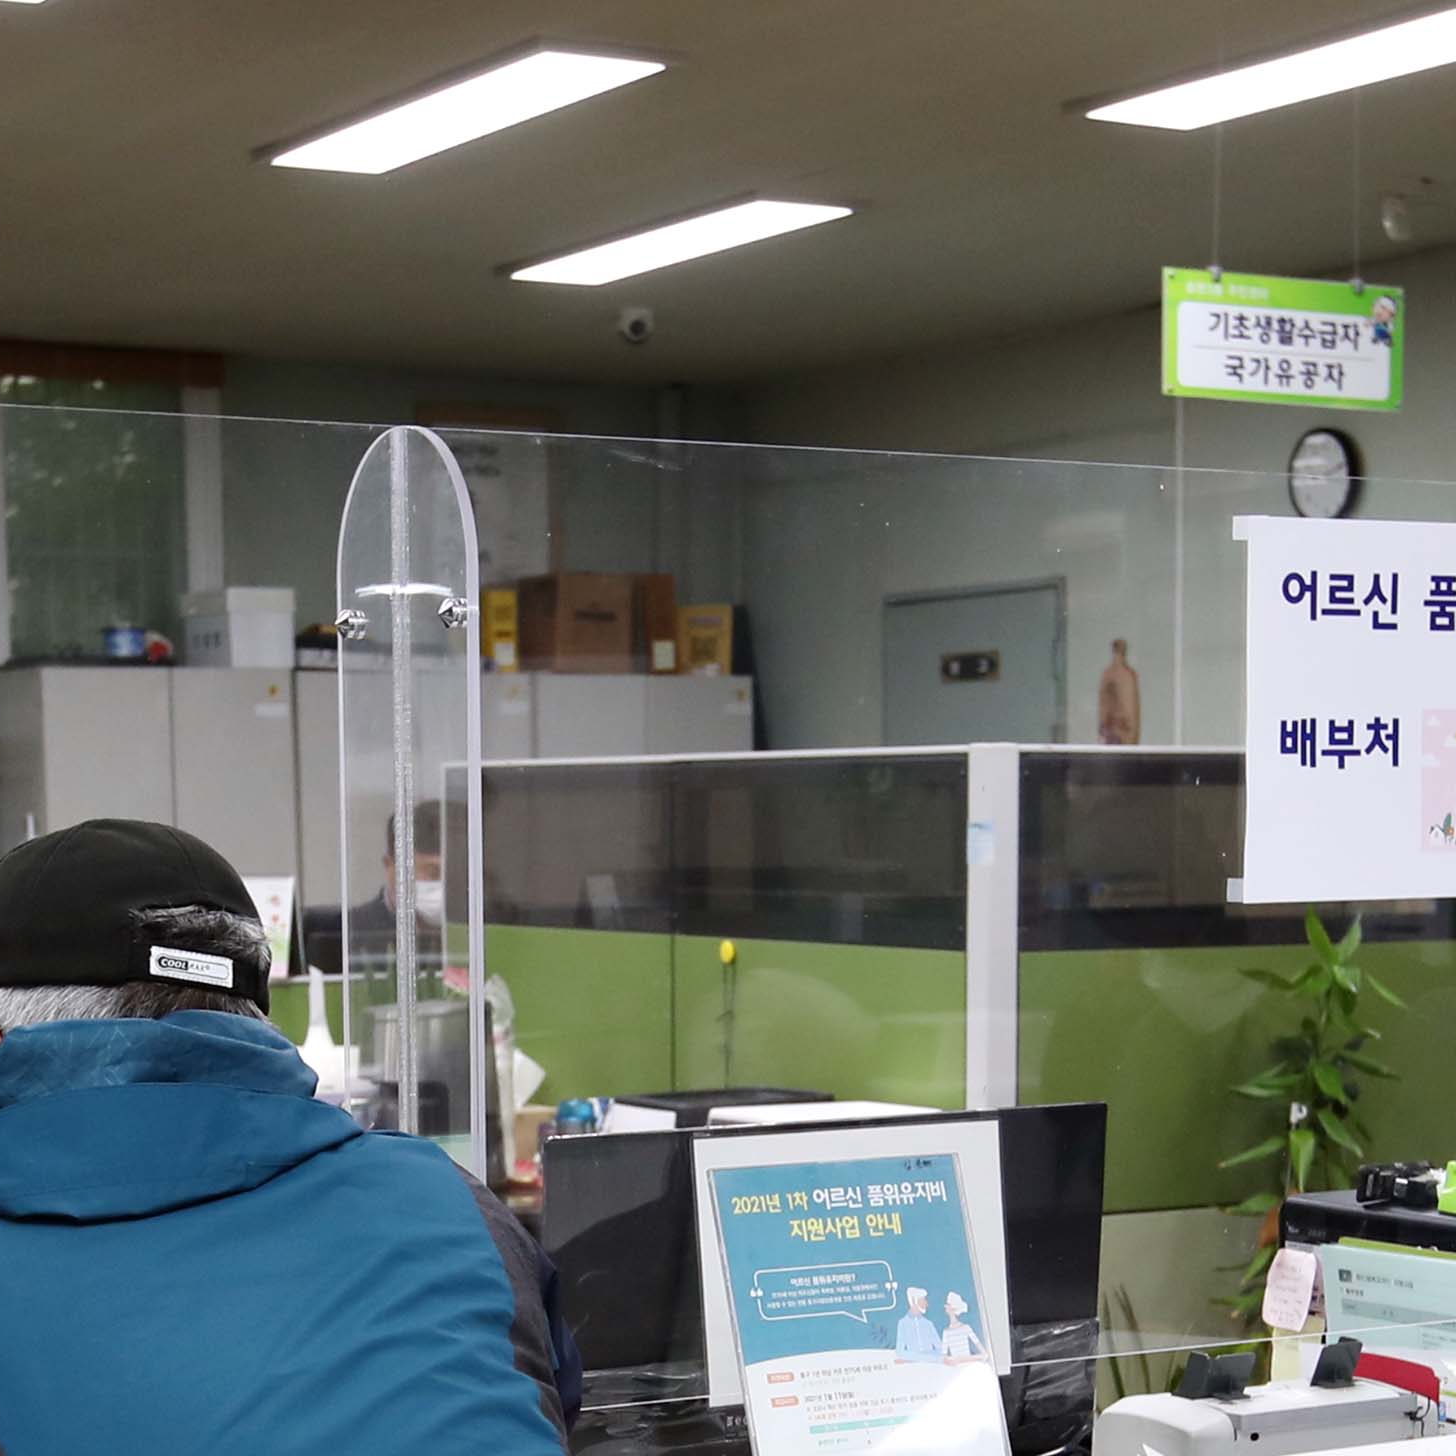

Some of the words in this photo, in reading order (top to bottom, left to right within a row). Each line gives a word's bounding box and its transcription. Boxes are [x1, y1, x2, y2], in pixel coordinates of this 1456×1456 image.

[1208, 311, 1361, 350] 기초생활수급자
[1224, 354, 1346, 391] 국가유공자
[1281, 569, 1400, 631] 어르신
[1279, 716, 1401, 770] 배부처
[731, 1193, 782, 1215] 2021년
[786, 1191, 809, 1211] 1차
[812, 1186, 862, 1210] 어르신
[867, 1180, 948, 1207] 품위유지비
[789, 1215, 861, 1242] 지원사업
[865, 1211, 903, 1237] 안내
